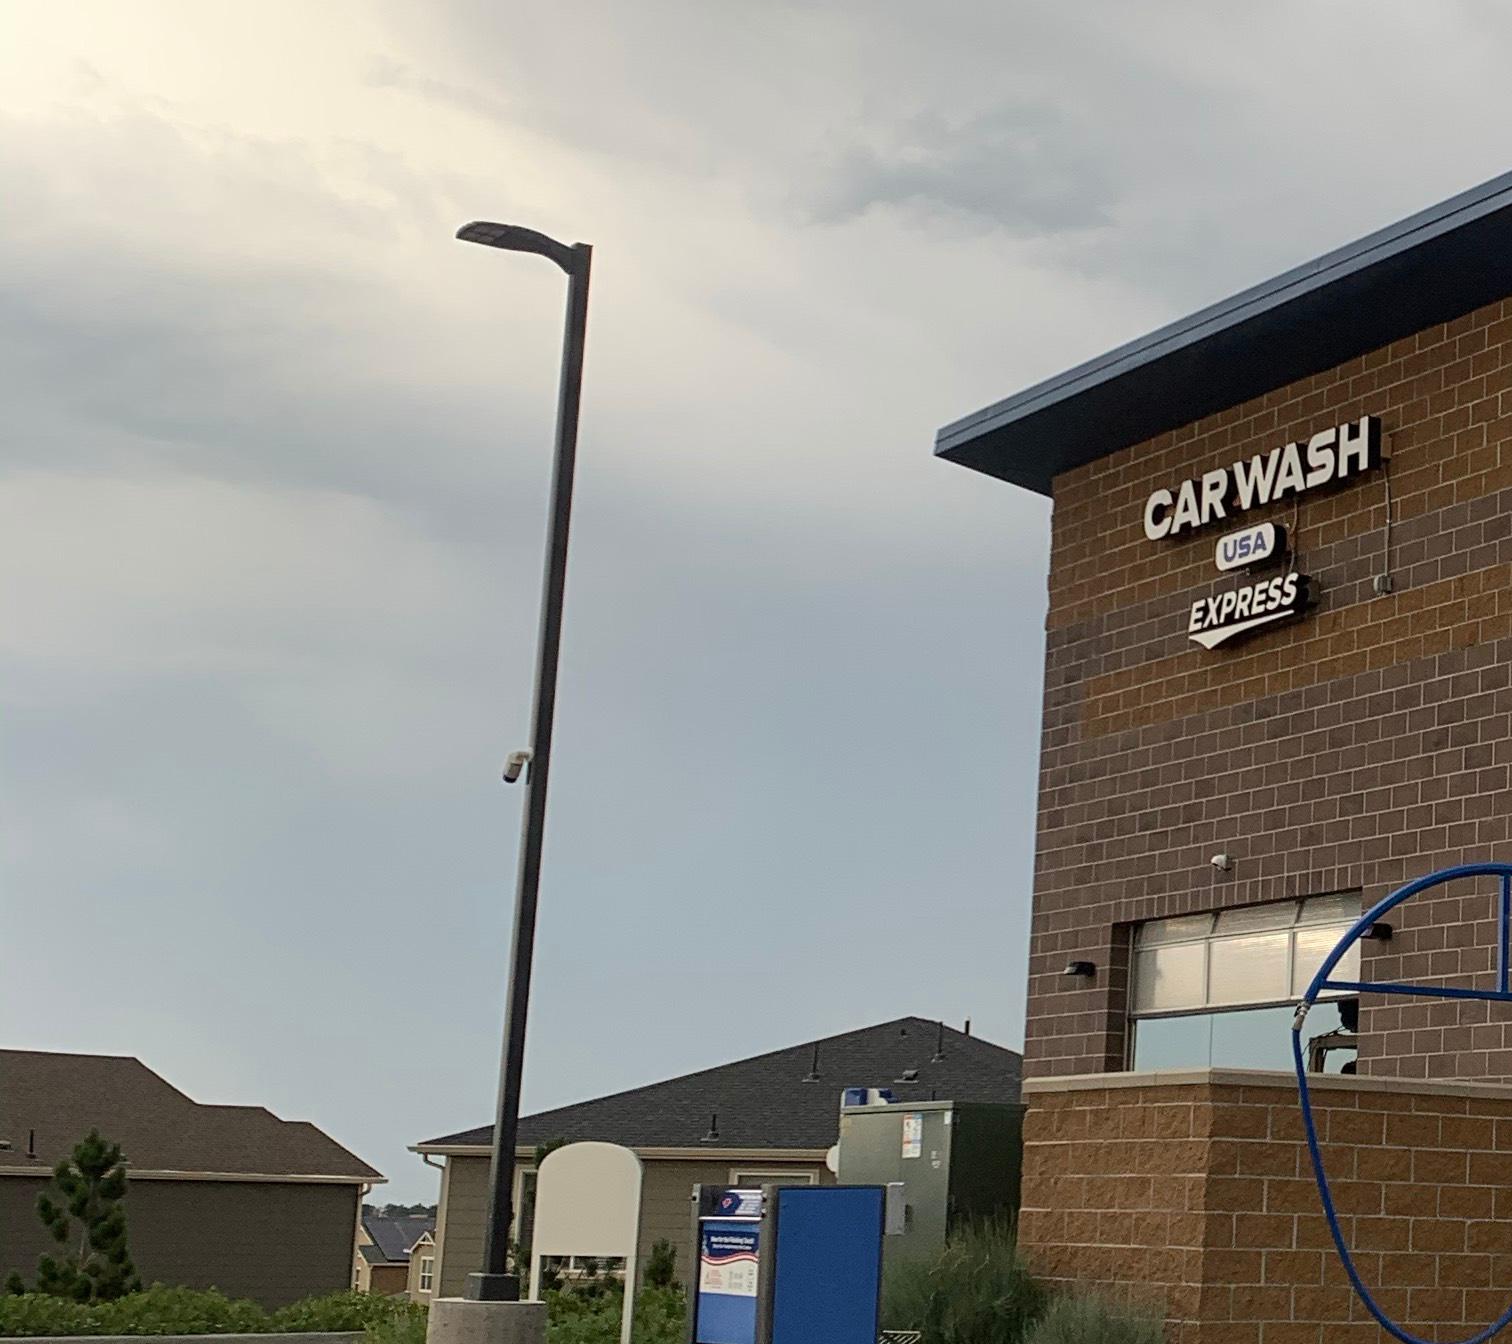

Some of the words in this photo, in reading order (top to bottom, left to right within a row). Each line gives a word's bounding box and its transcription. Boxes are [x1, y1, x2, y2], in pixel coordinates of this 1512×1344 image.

[1144, 468, 1228, 540] CAR
[1233, 415, 1371, 511] WASH
[1223, 531, 1267, 563] USA
[1188, 572, 1299, 633] EXPRESS
